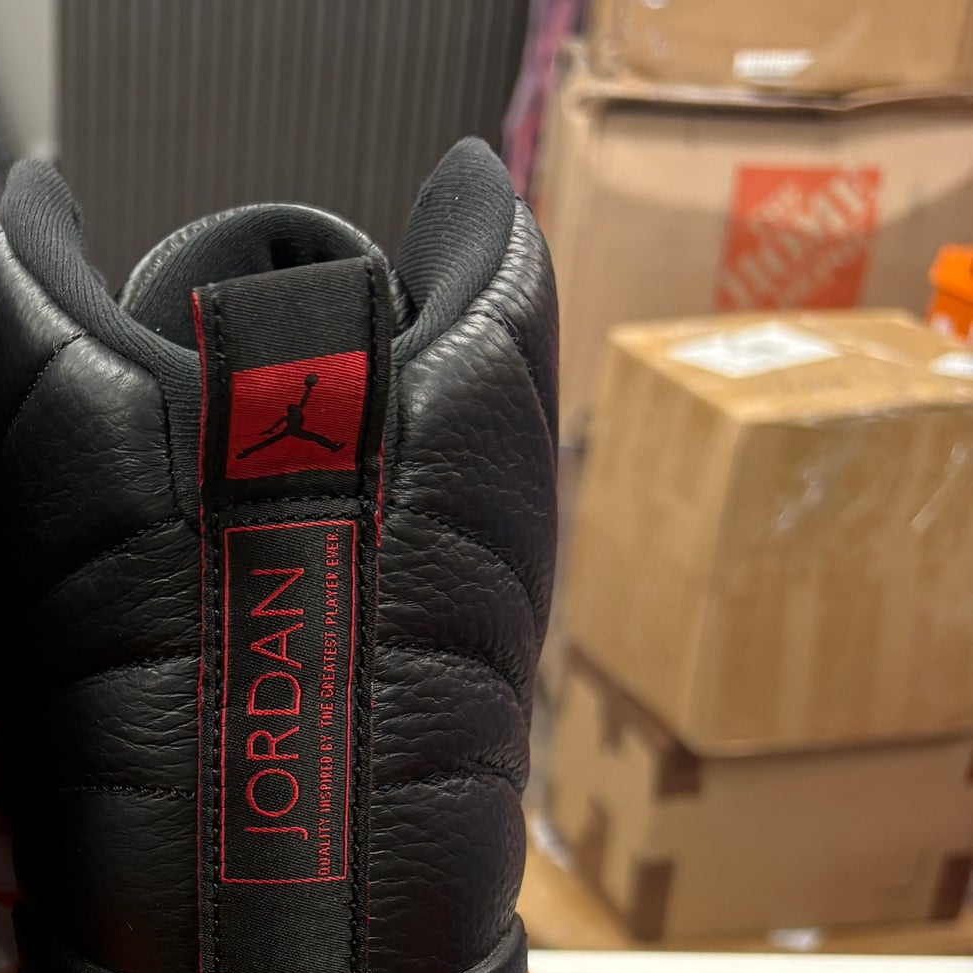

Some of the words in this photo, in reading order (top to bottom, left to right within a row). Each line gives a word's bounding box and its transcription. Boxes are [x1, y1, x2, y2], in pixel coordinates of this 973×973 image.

[325, 572, 339, 625] PLAYER
[321, 632, 339, 698] GREATEST
[246, 568, 308, 841] JORDAN
[320, 703, 334, 728] THE
[321, 735, 333, 752] BY
[317, 818, 331, 876] QUALITY
